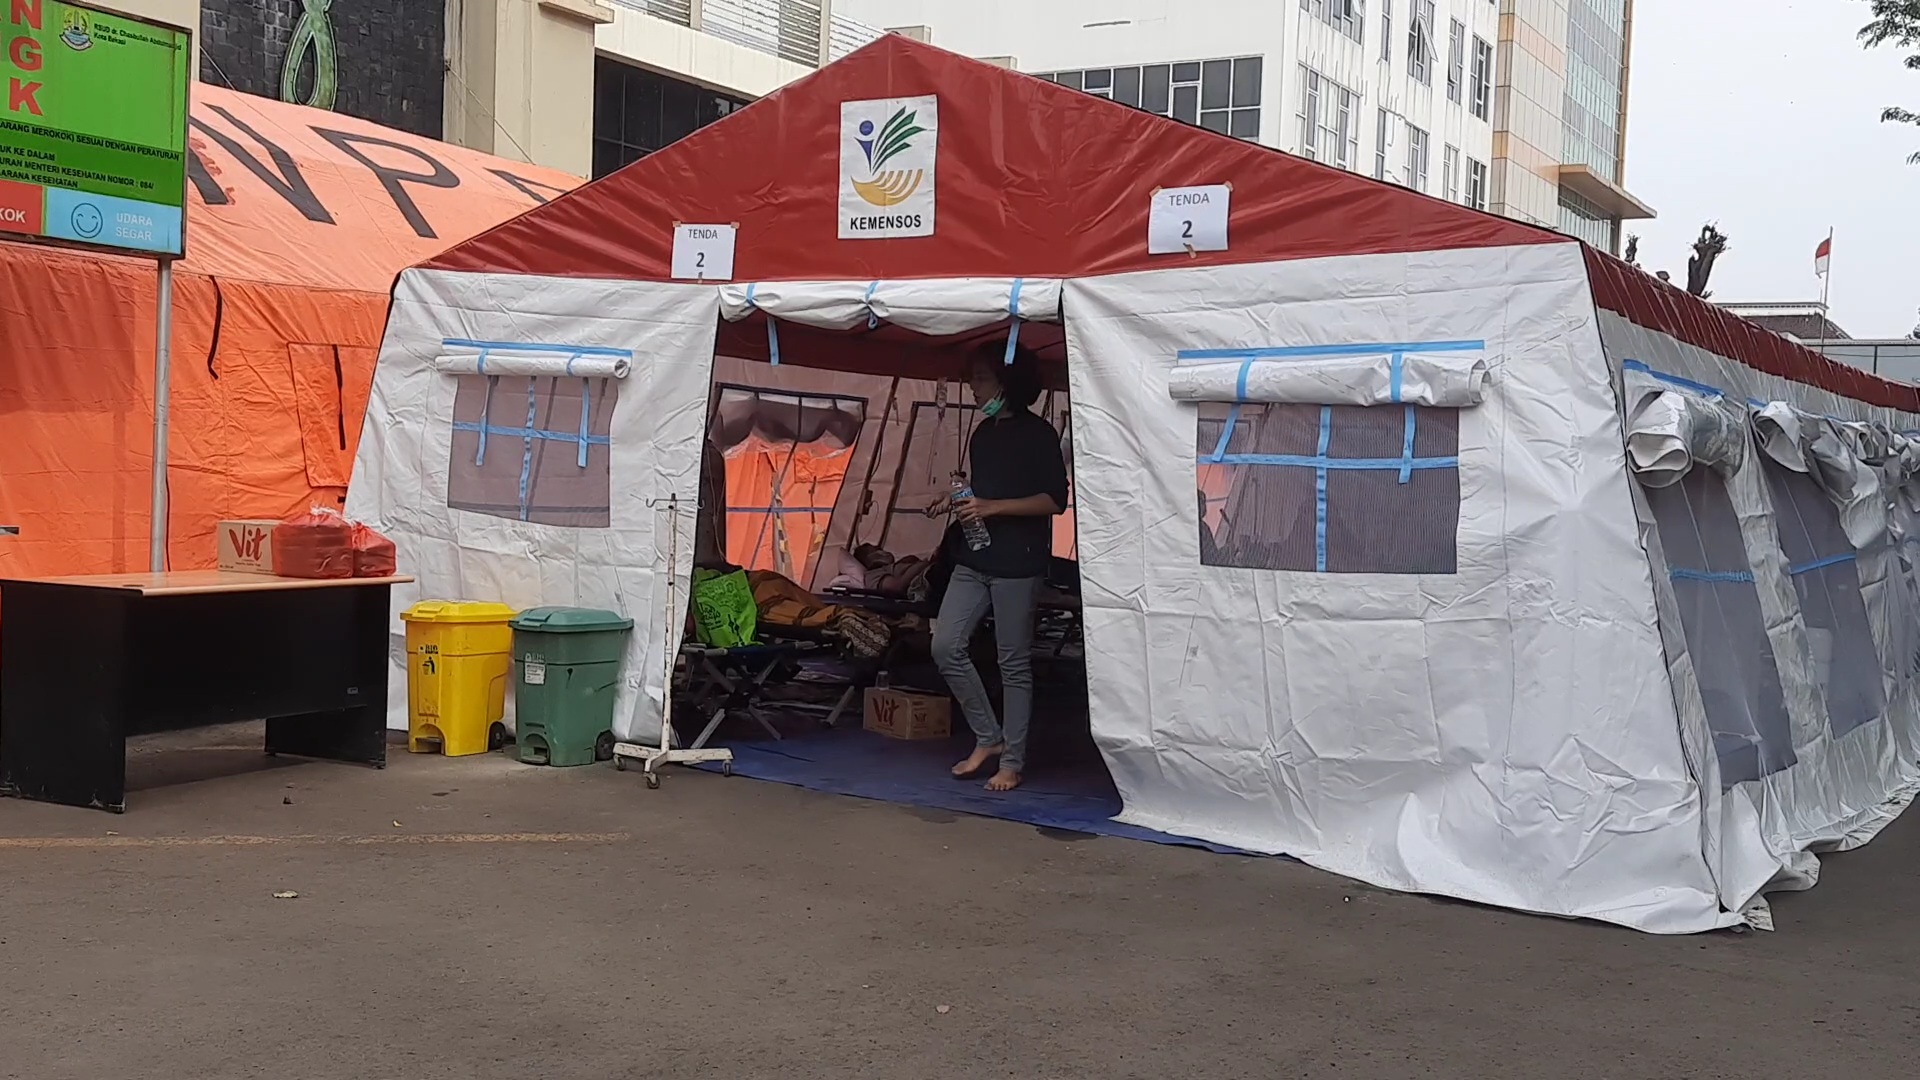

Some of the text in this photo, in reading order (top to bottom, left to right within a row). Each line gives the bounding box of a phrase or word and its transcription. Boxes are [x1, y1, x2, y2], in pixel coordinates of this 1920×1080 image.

[0, 120, 180, 161] ARANG MEROKOK) SESUAI DENGAN PERATURAN
[0, 144, 56, 161] UK KE DALAM
[0, 157, 22, 168] URAN
[25, 160, 60, 174] MENTERI
[61, 166, 106, 182] KESEHATAN
[107, 174, 135, 186] NOMOR
[0, 169, 78, 188] ARANA KESEHATAN
[1168, 193, 1210, 207] TENDA
[116, 212, 153, 226] UDARA
[850, 214, 922, 231] KEMENSOS
[115, 226, 152, 241] SEGAR
[687, 228, 719, 240] TENDA
[1181, 219, 1193, 239] 2
[695, 251, 705, 268] 2
[228, 524, 268, 561] Vit
[872, 695, 900, 727] Vit
